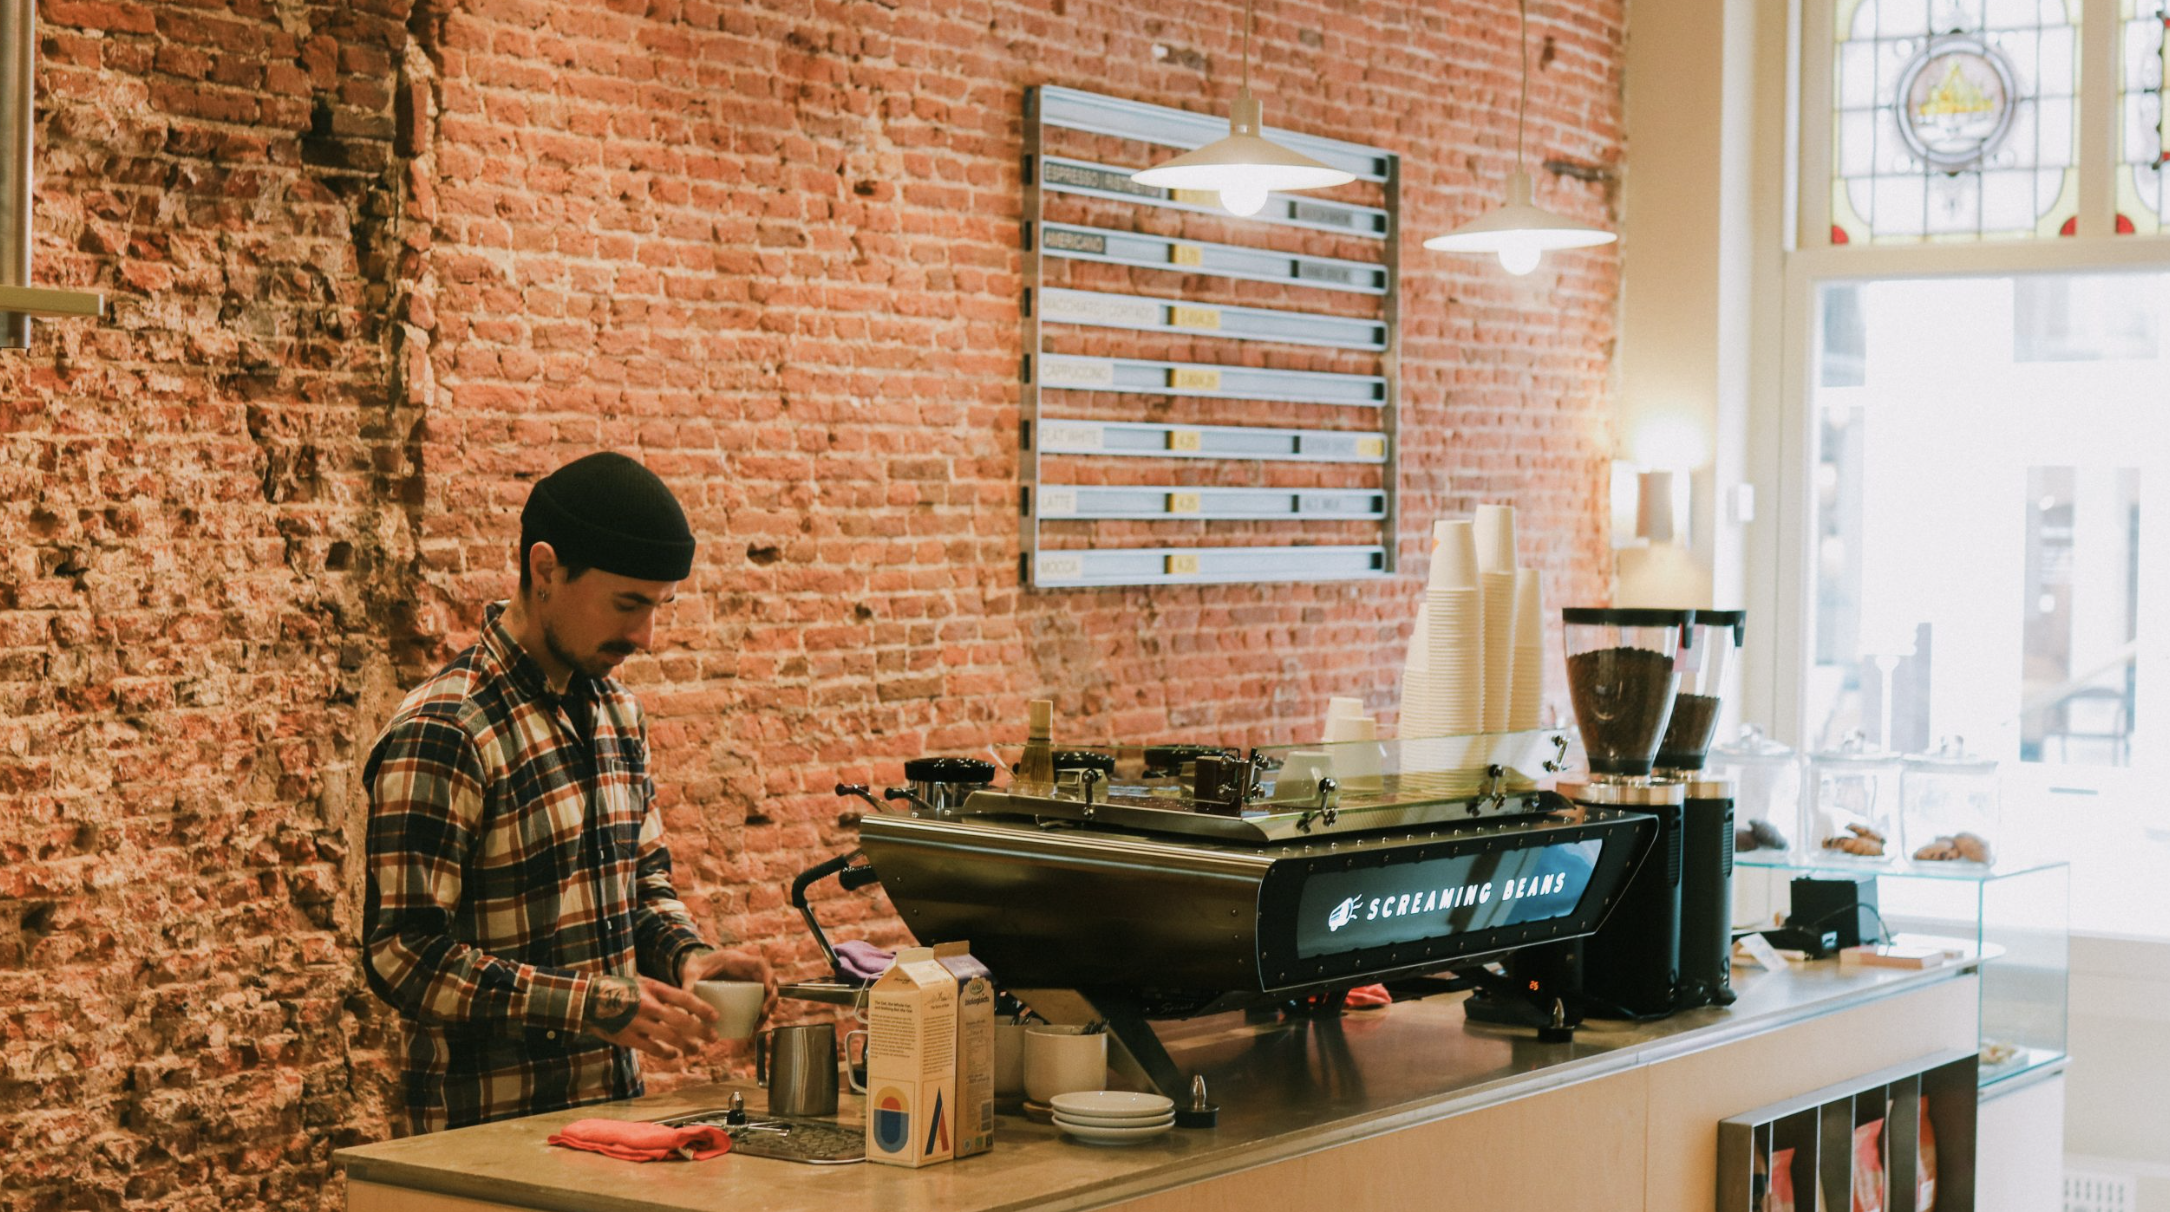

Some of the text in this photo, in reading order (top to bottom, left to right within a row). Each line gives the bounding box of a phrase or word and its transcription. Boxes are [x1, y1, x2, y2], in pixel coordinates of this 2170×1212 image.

[1045, 164, 1099, 187] ESPRESSO
[1045, 231, 1104, 252] AMERICANO
[1043, 362, 1108, 380] CAPPUCCINO
[1066, 429, 1098, 446] WHITE
[1041, 494, 1072, 510] LATTE
[1040, 560, 1078, 574] MOCCA
[1367, 872, 1566, 921] SCREAMING BEANS
